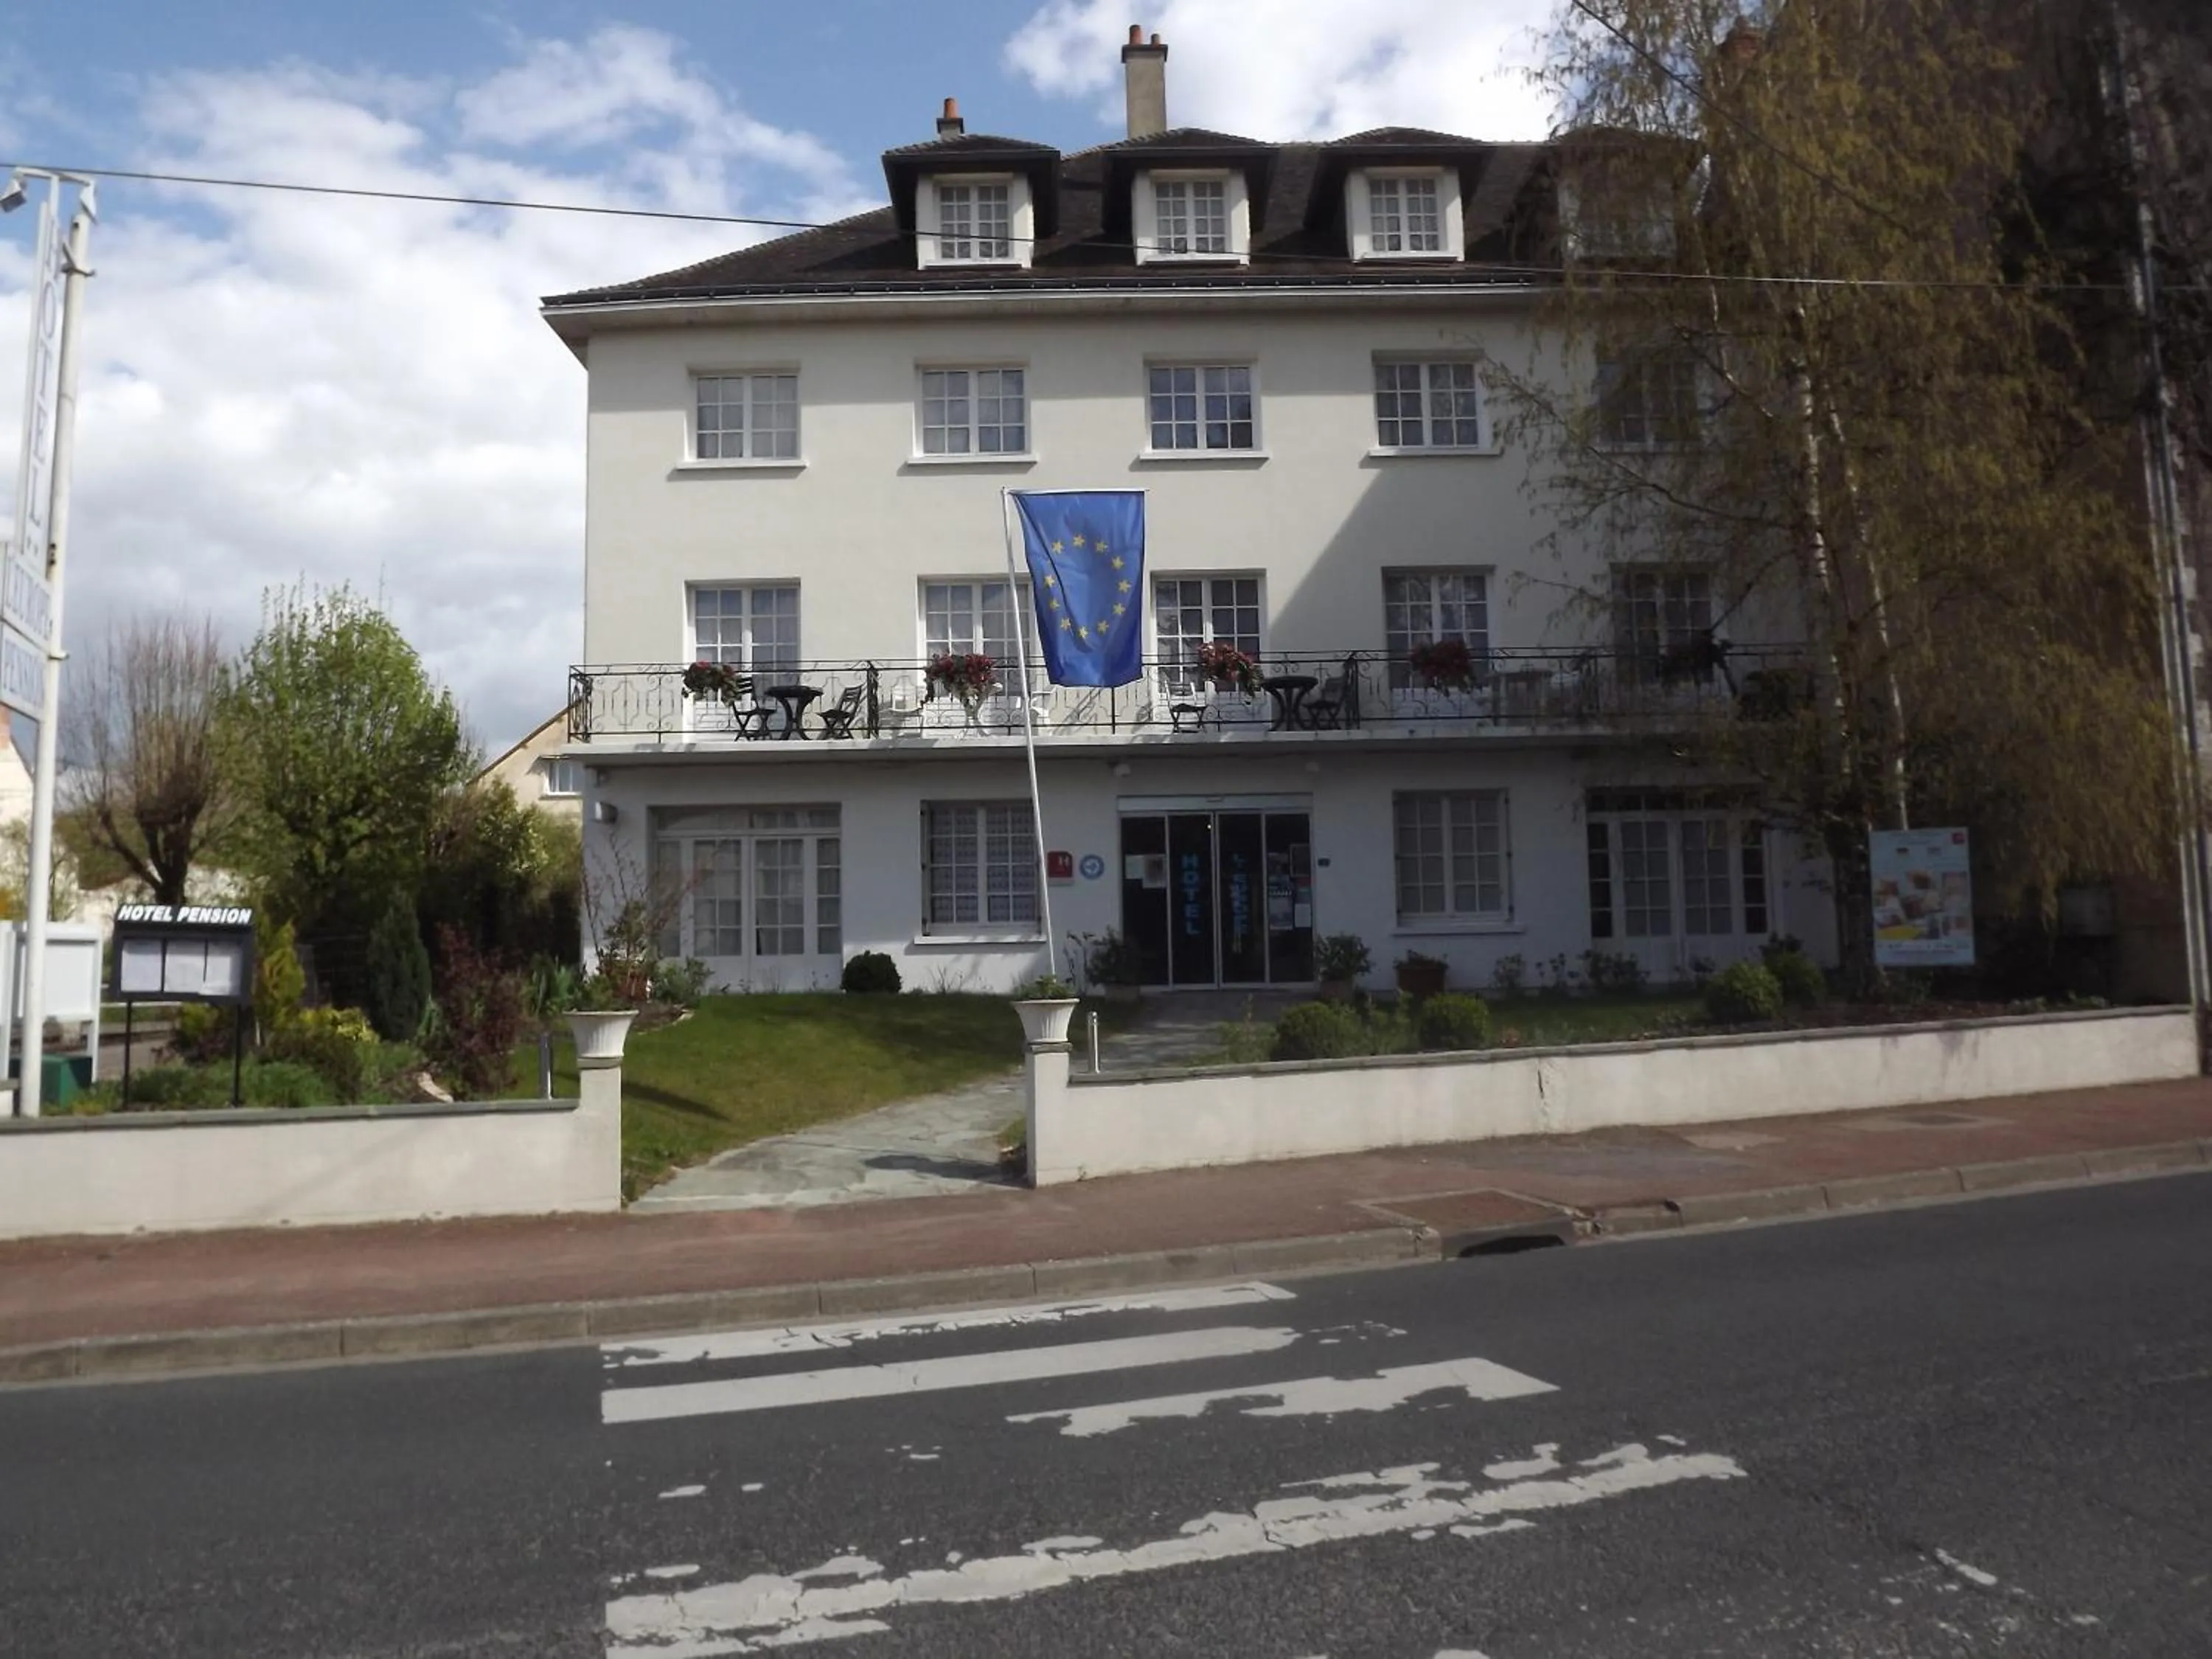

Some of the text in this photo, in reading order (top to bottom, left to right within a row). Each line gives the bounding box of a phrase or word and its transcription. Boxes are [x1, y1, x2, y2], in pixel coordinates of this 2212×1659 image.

[29, 218, 62, 528] HOTEL
[117, 905, 252, 924] HOTEL PENSION
[1181, 853, 1200, 935] HOTEL
